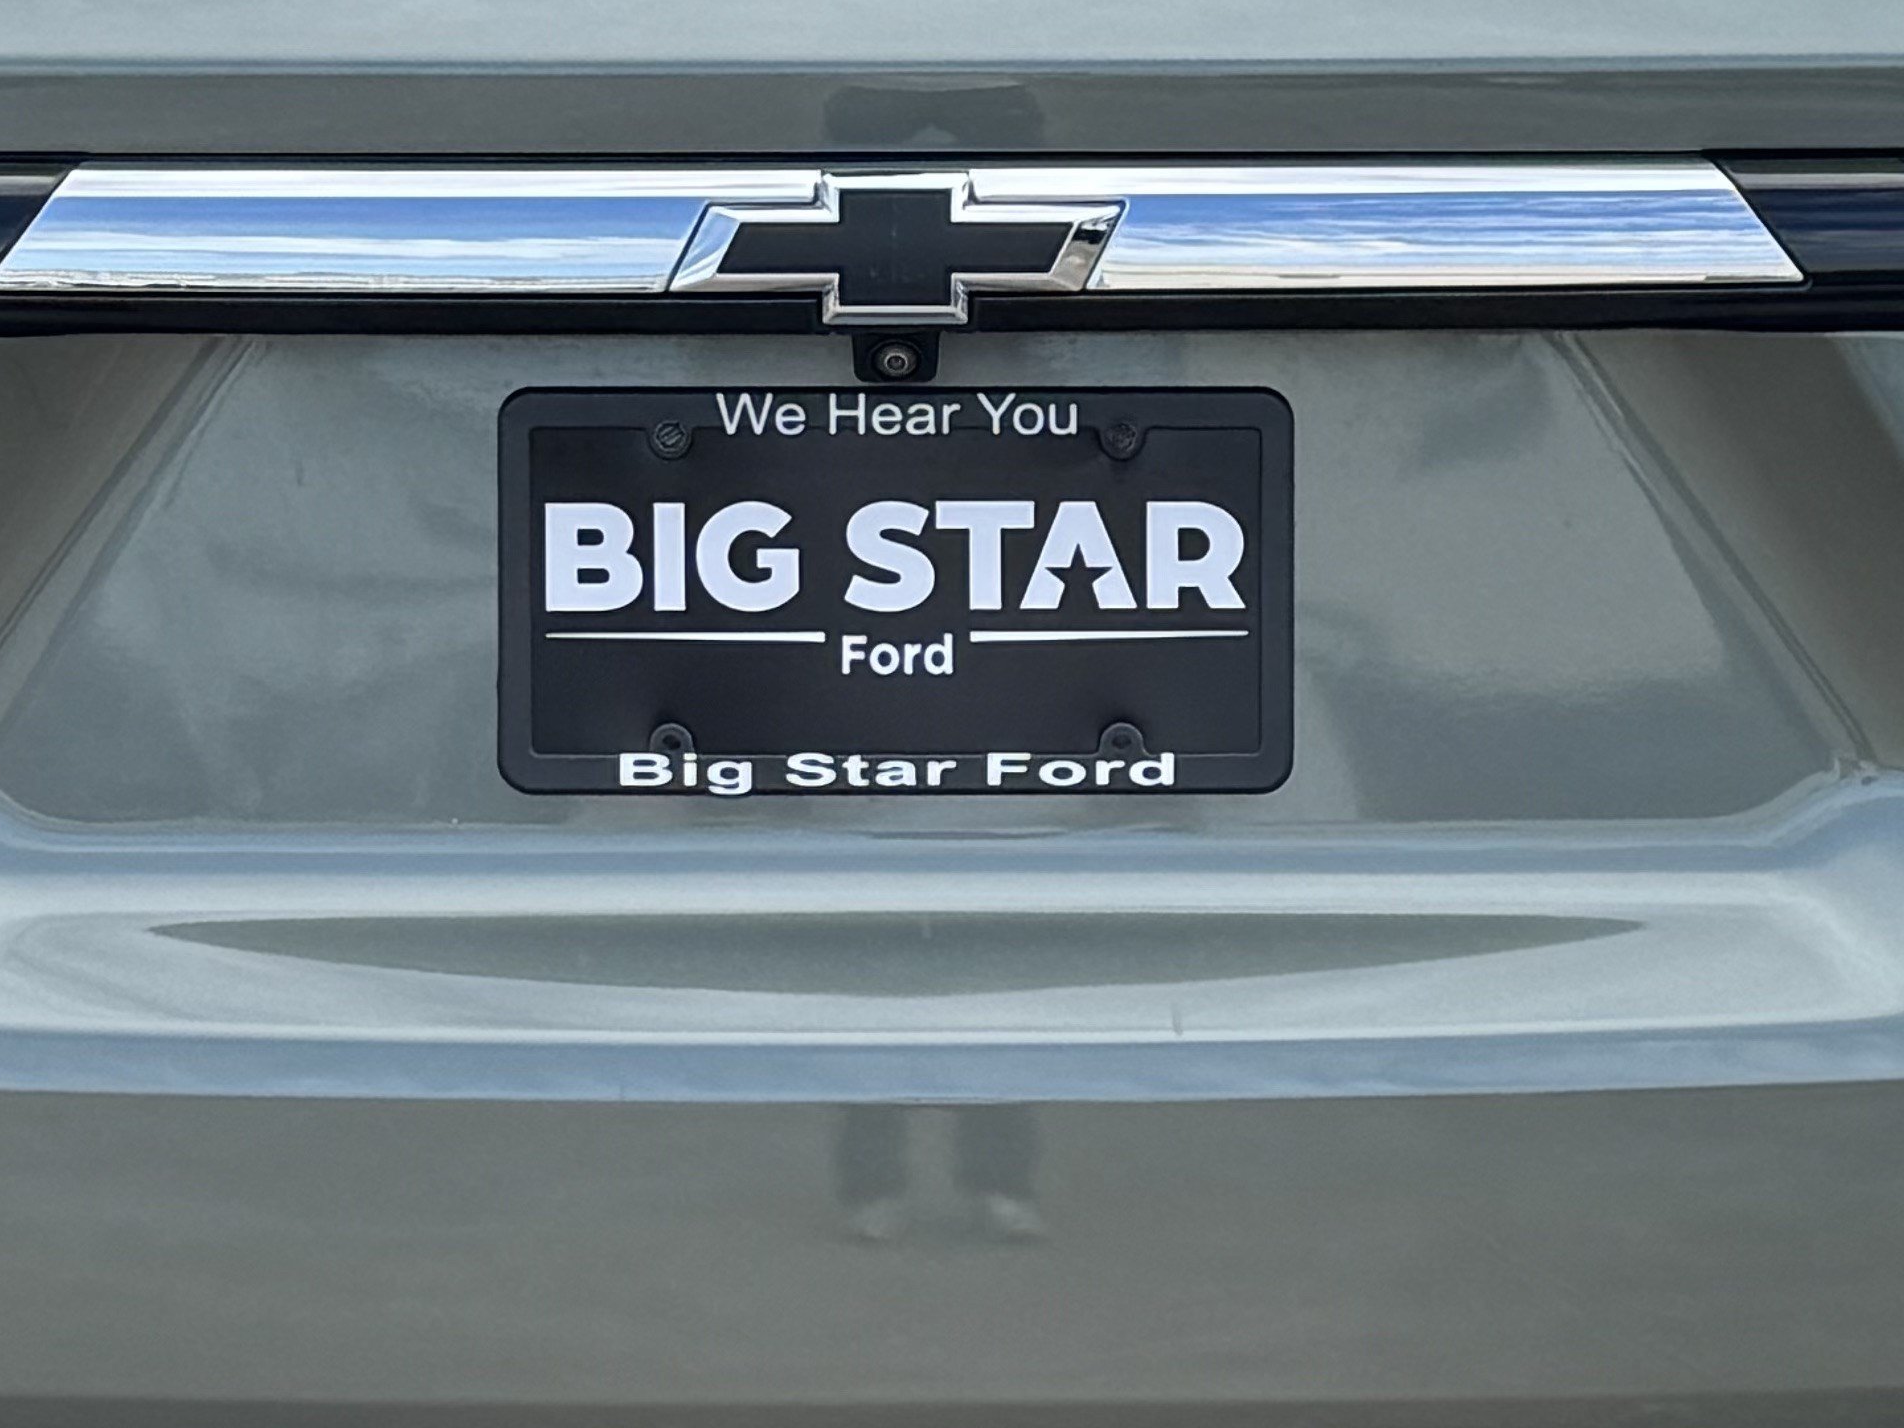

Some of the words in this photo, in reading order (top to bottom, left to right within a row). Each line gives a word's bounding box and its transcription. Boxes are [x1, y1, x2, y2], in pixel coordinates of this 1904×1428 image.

[716, 392, 806, 436] We
[828, 392, 961, 436] Hear
[976, 392, 1078, 436] You
[544, 501, 800, 612] BIG
[844, 501, 1246, 612] STAR
[841, 633, 954, 676] Ford
[619, 752, 753, 795] Big
[785, 752, 957, 787] Star
[986, 752, 1175, 787] Ford
